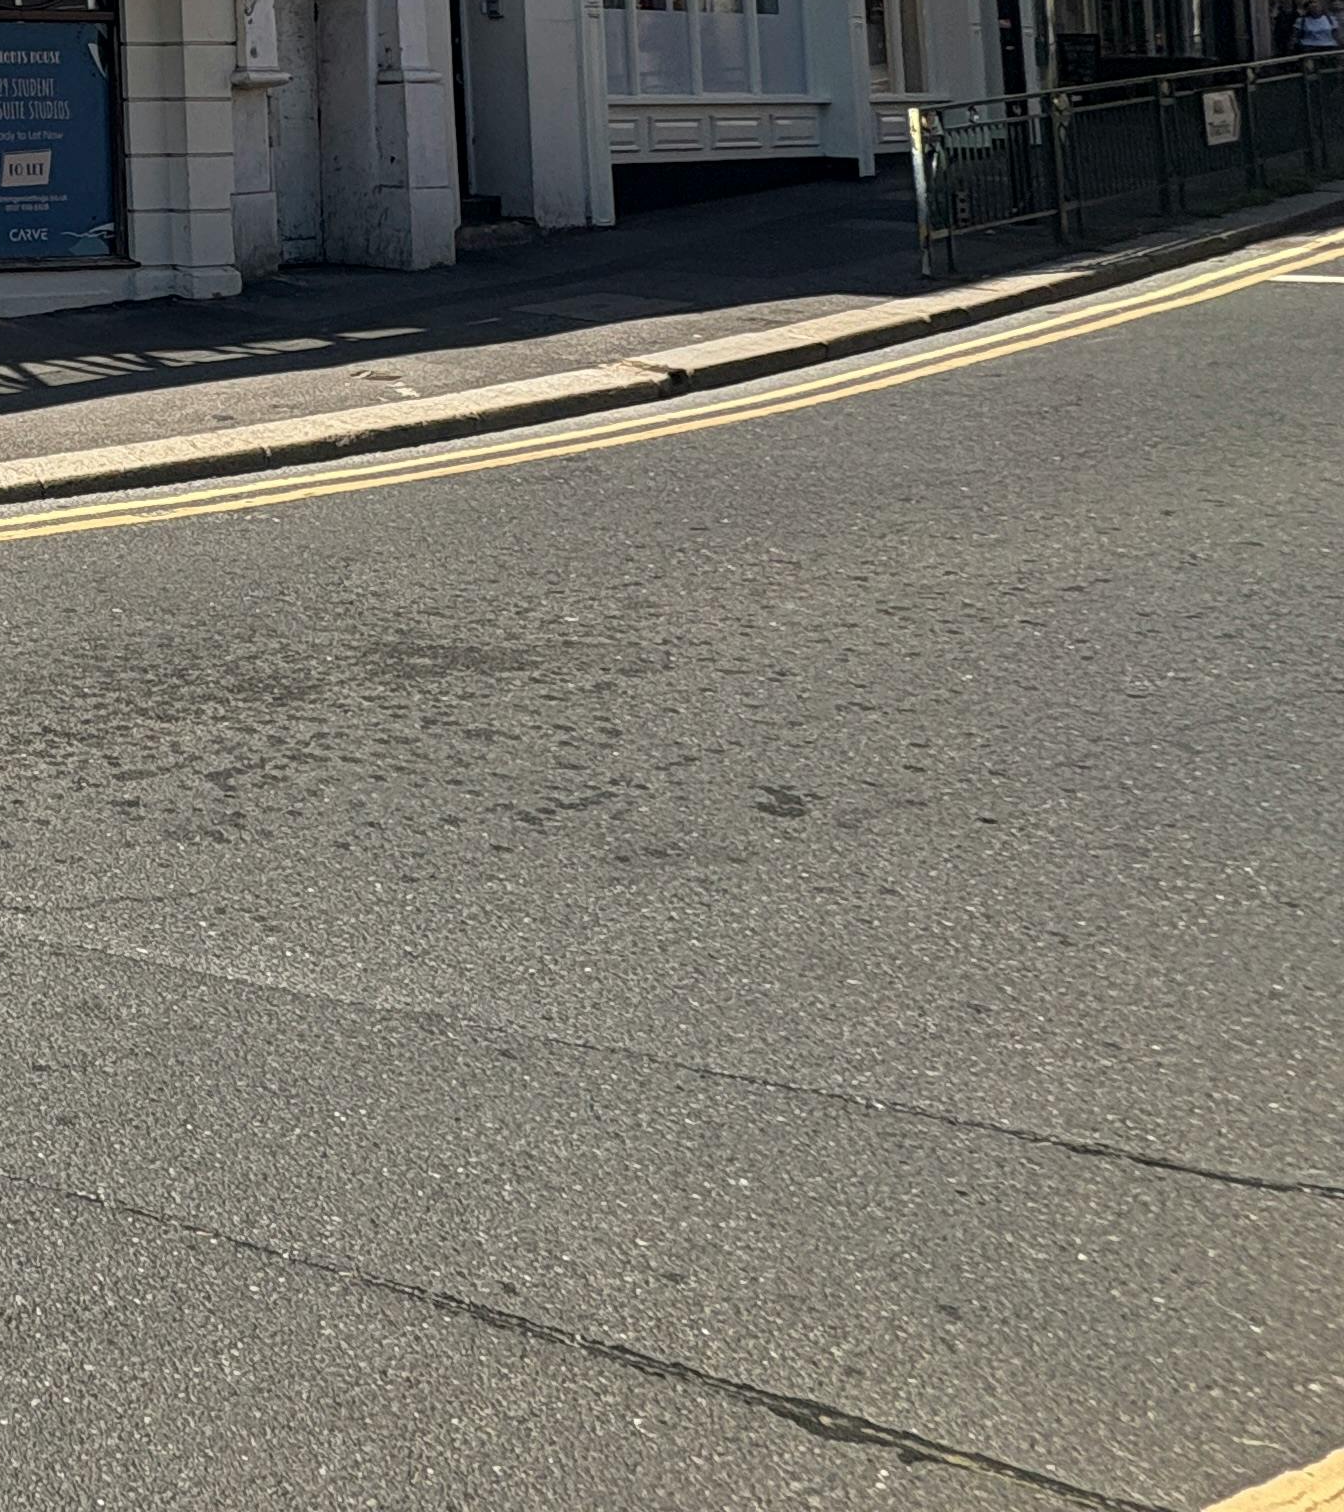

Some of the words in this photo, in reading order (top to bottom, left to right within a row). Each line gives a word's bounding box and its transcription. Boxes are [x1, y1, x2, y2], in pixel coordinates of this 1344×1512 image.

[11, 77, 55, 97] STUDENT
[28, 100, 70, 120] STUDIOS
[16, 131, 27, 140] to
[9, 163, 24, 176] TO
[26, 162, 45, 176] LET
[9, 228, 49, 242] CARVE
